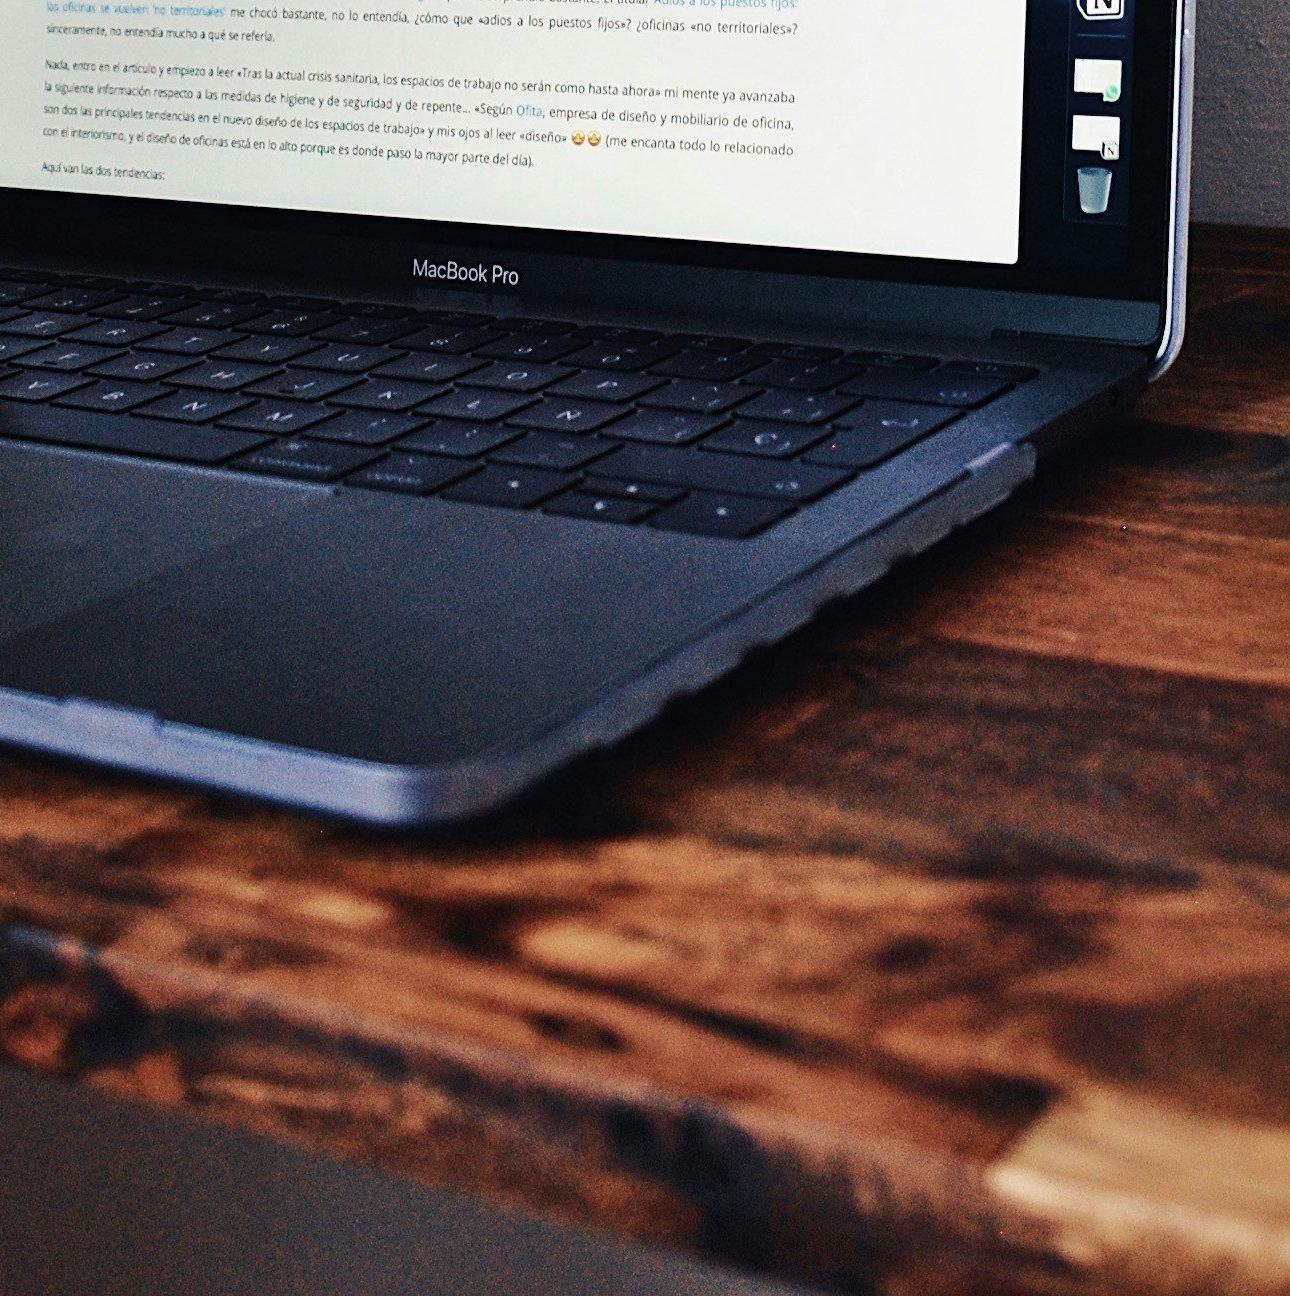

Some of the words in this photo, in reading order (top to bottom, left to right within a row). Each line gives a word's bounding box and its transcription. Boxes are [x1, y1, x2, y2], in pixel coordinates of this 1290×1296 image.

[249, 7, 278, 18] chocó
[281, 8, 327, 20] bastante,
[362, 12, 410, 23] entendía,
[414, 13, 449, 25] ¿cómo
[452, 16, 473, 27] que
[478, 15, 512, 26] «adios
[527, 15, 544, 27] los
[548, 19, 592, 29] puestos
[597, 17, 632, 32] fijos»?
[635, 19, 685, 32] ¿oficinas
[717, 22, 798, 34] territoriales»?
[165, 67, 206, 78] empiezo
[216, 67, 234, 77] leer
[275, 71, 305, 81] actual
[307, 73, 332, 82] crisis
[334, 74, 380, 85] sanitaria,
[383, 75, 398, 85] los
[400, 77, 445, 88] espacios
[447, 78, 461, 88] de
[463, 78, 502, 93] trabajo
[503, 82, 518, 90] no
[521, 81, 551, 91] serán
[554, 84, 585, 93] como
[587, 83, 619, 95] hasta
[621, 85, 661, 96] ahora»
[664, 89, 678, 97] mi
[681, 90, 719, 99] mente
[721, 92, 736, 103] ya
[739, 92, 795, 103] avanzaba
[153, 89, 194, 99] respecto
[220, 92, 262, 102] medidas
[279, 93, 316, 107] higiene
[342, 98, 393, 110] seguridad
[404, 100, 418, 110] de
[474, 103, 513, 117] «Según
[515, 105, 545, 118] Ofita,
[549, 109, 597, 121] empresa
[601, 111, 615, 120] de
[618, 111, 657, 122] diseño
[670, 113, 729, 126] mobiliario
[751, 117, 794, 130] oficina,
[145, 111, 195, 122] tendencias
[222, 116, 253, 125] nuevo
[254, 116, 288, 127] diseño
[304, 118, 319, 129] los
[321, 122, 365, 133] espacios
[383, 124, 425, 137] trabajo»
[436, 128, 456, 137] mis
[458, 129, 480, 140] ojos
[495, 129, 516, 140] leer
[519, 131, 567, 142] «diseño»
[605, 135, 627, 147] (me
[630, 139, 676, 149] encanta
[679, 140, 706, 151] todo
[724, 142, 794, 155] relacionado
[192, 135, 229, 147] oficinas
[230, 138, 251, 148] está
[278, 141, 298, 151] alto
[299, 144, 336, 156] porque
[351, 146, 384, 157] donde
[386, 149, 412, 160] paso
[425, 152, 459, 164] mayor
[461, 154, 490, 164] parte
[492, 154, 509, 165] del
[511, 155, 534, 167] día).
[412, 257, 488, 283] MacBook
[492, 264, 519, 286] Pro
